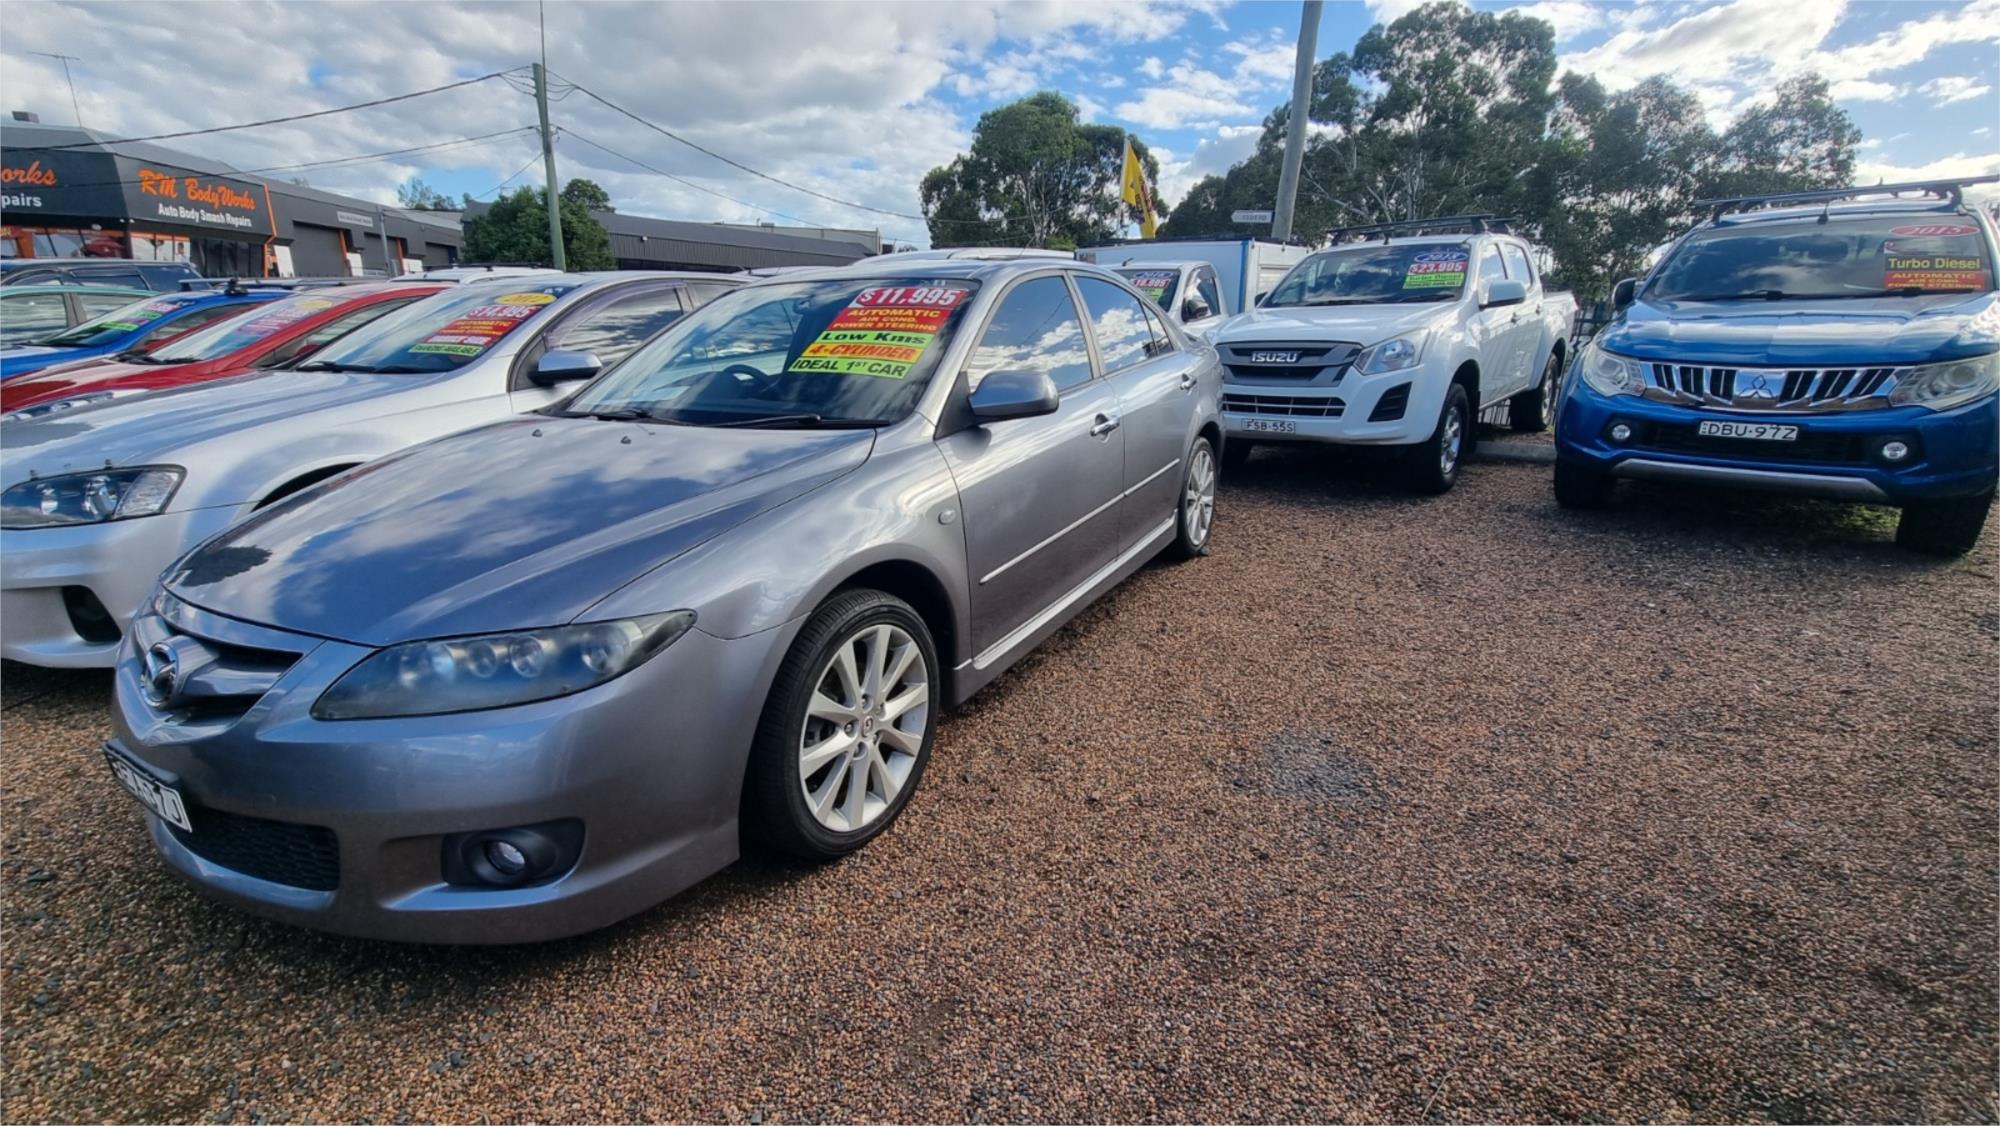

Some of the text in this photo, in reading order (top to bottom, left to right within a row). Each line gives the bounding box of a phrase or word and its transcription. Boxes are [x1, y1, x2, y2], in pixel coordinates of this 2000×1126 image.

[138, 168, 177, 198] RM
[158, 203, 252, 228] Auto Body Smash Repairs
[1888, 257, 1980, 269] Turbo Diesel
[1891, 272, 1977, 280] AUTOMATIC
[860, 287, 960, 306] $11,995
[848, 307, 941, 318] AUTOMATIC
[877, 322, 938, 331] STEERING
[809, 344, 917, 360] 4-CYLINDER
[1252, 352, 1298, 362] ISUZU
[793, 359, 838, 371] IDEAL
[868, 363, 906, 376] CAR
